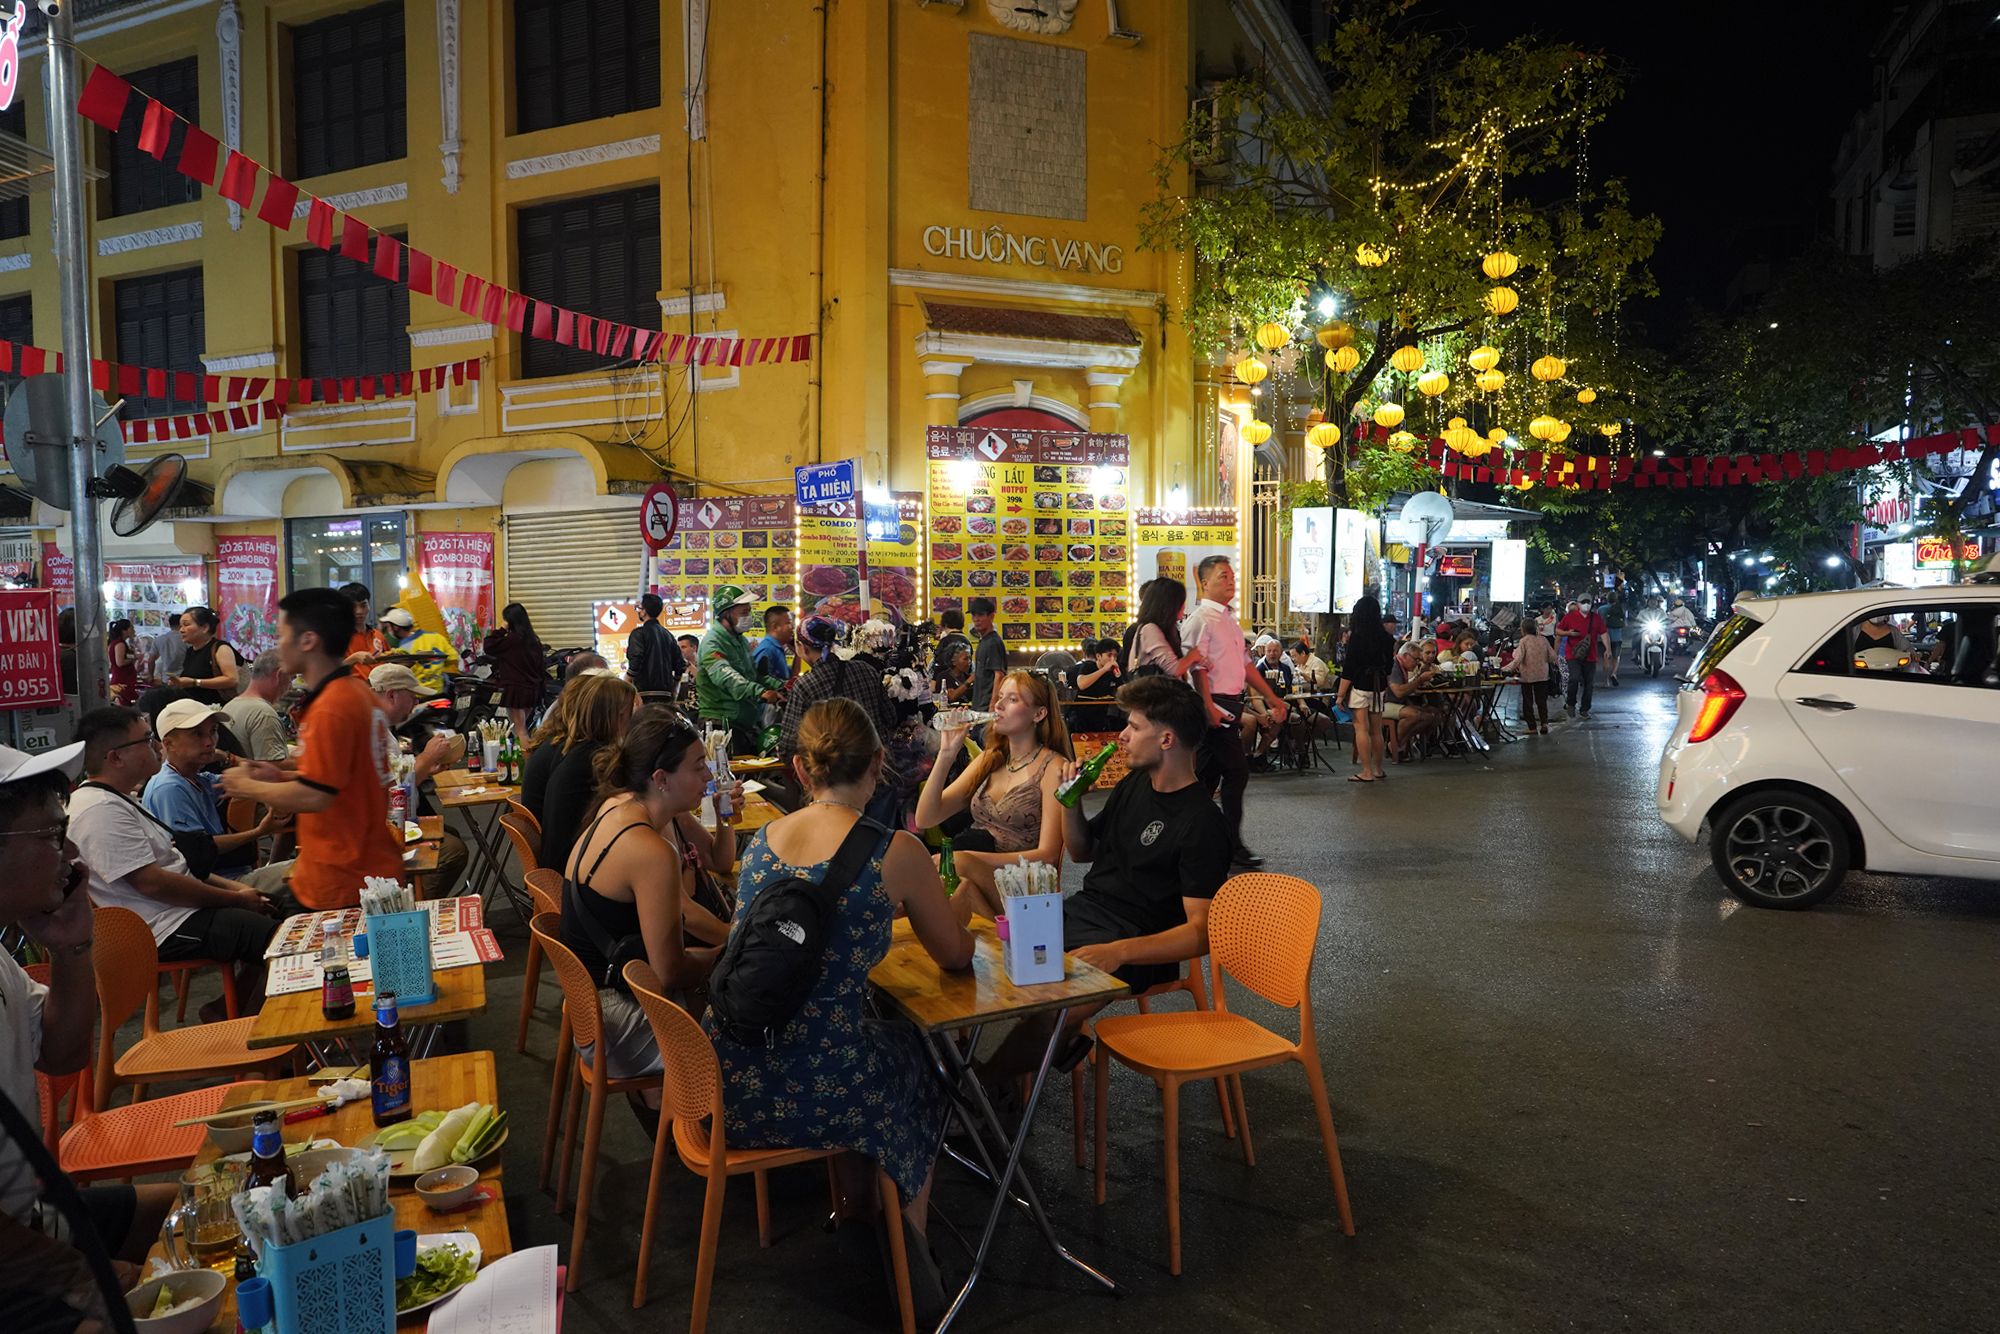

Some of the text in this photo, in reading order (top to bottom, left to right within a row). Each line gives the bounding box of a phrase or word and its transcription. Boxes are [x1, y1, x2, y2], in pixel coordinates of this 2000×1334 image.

[923, 225, 1046, 265] CHUÔNG
[818, 467, 836, 478] PHỐ
[802, 479, 850, 501] TẠ HIỆN
[1141, 530, 1159, 541] 음식
[1166, 530, 1184, 541] 음료
[1192, 530, 1209, 541] 열대
[1216, 530, 1233, 541] 과일
[219, 541, 276, 556] ZÔ 26 TẠ HIỆN
[424, 537, 491, 554] ZÔ 26 TẠ HIỆN
[228, 555, 269, 567] COMBO BBQ
[433, 553, 480, 566] COMBO BBQ
[7, 602, 48, 642] VIÊN
[377, 1080, 407, 1097] Tiger
